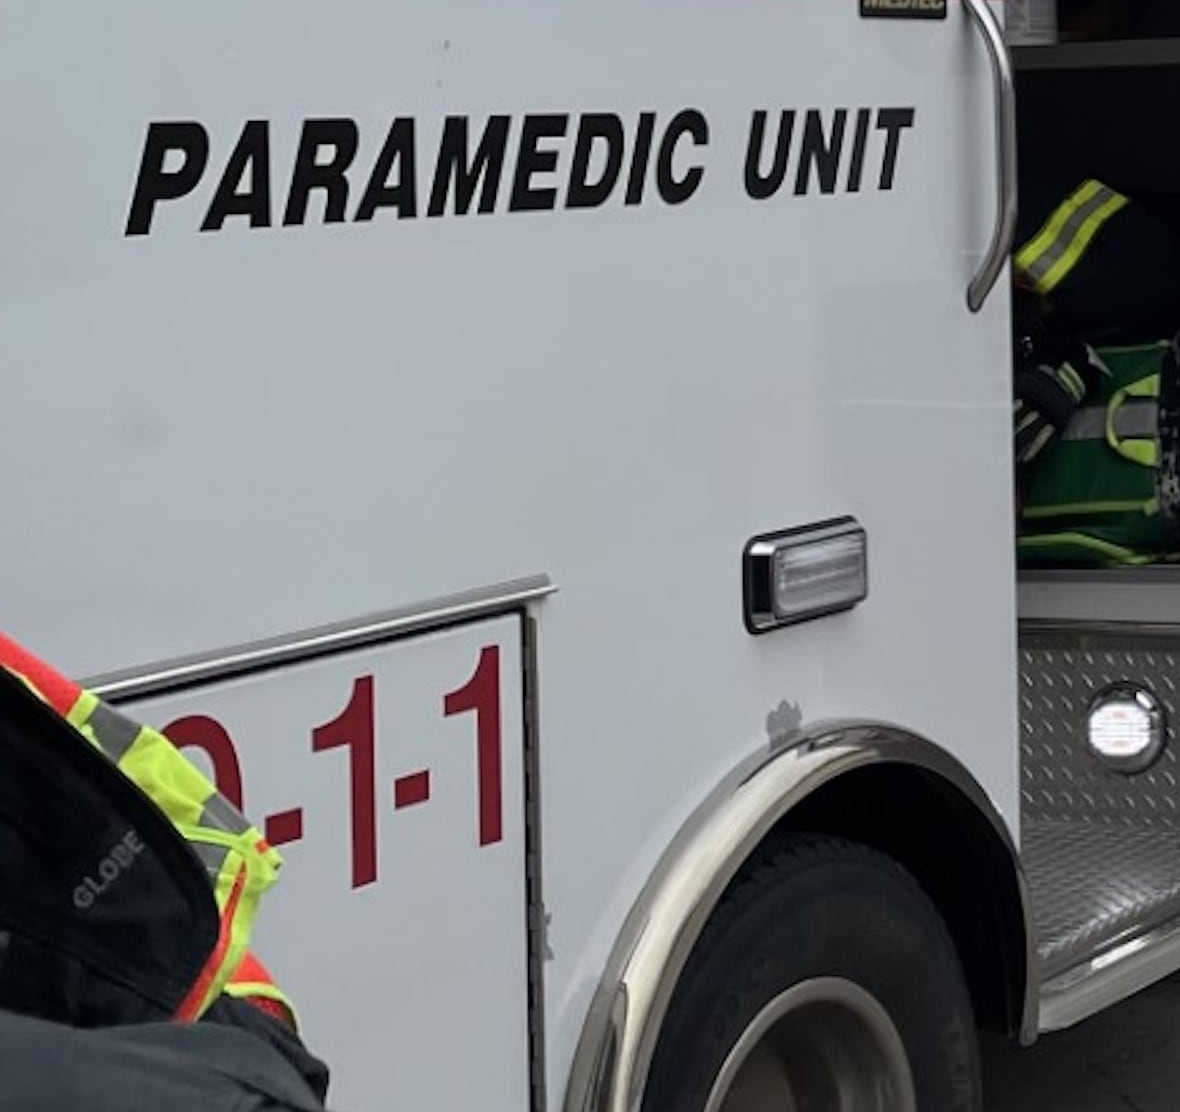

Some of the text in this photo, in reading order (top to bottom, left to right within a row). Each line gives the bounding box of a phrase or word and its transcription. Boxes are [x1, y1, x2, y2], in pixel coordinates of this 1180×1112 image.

[125, 107, 915, 236] PARAMEDIC UNIT
[73, 829, 146, 909] GLOBE
